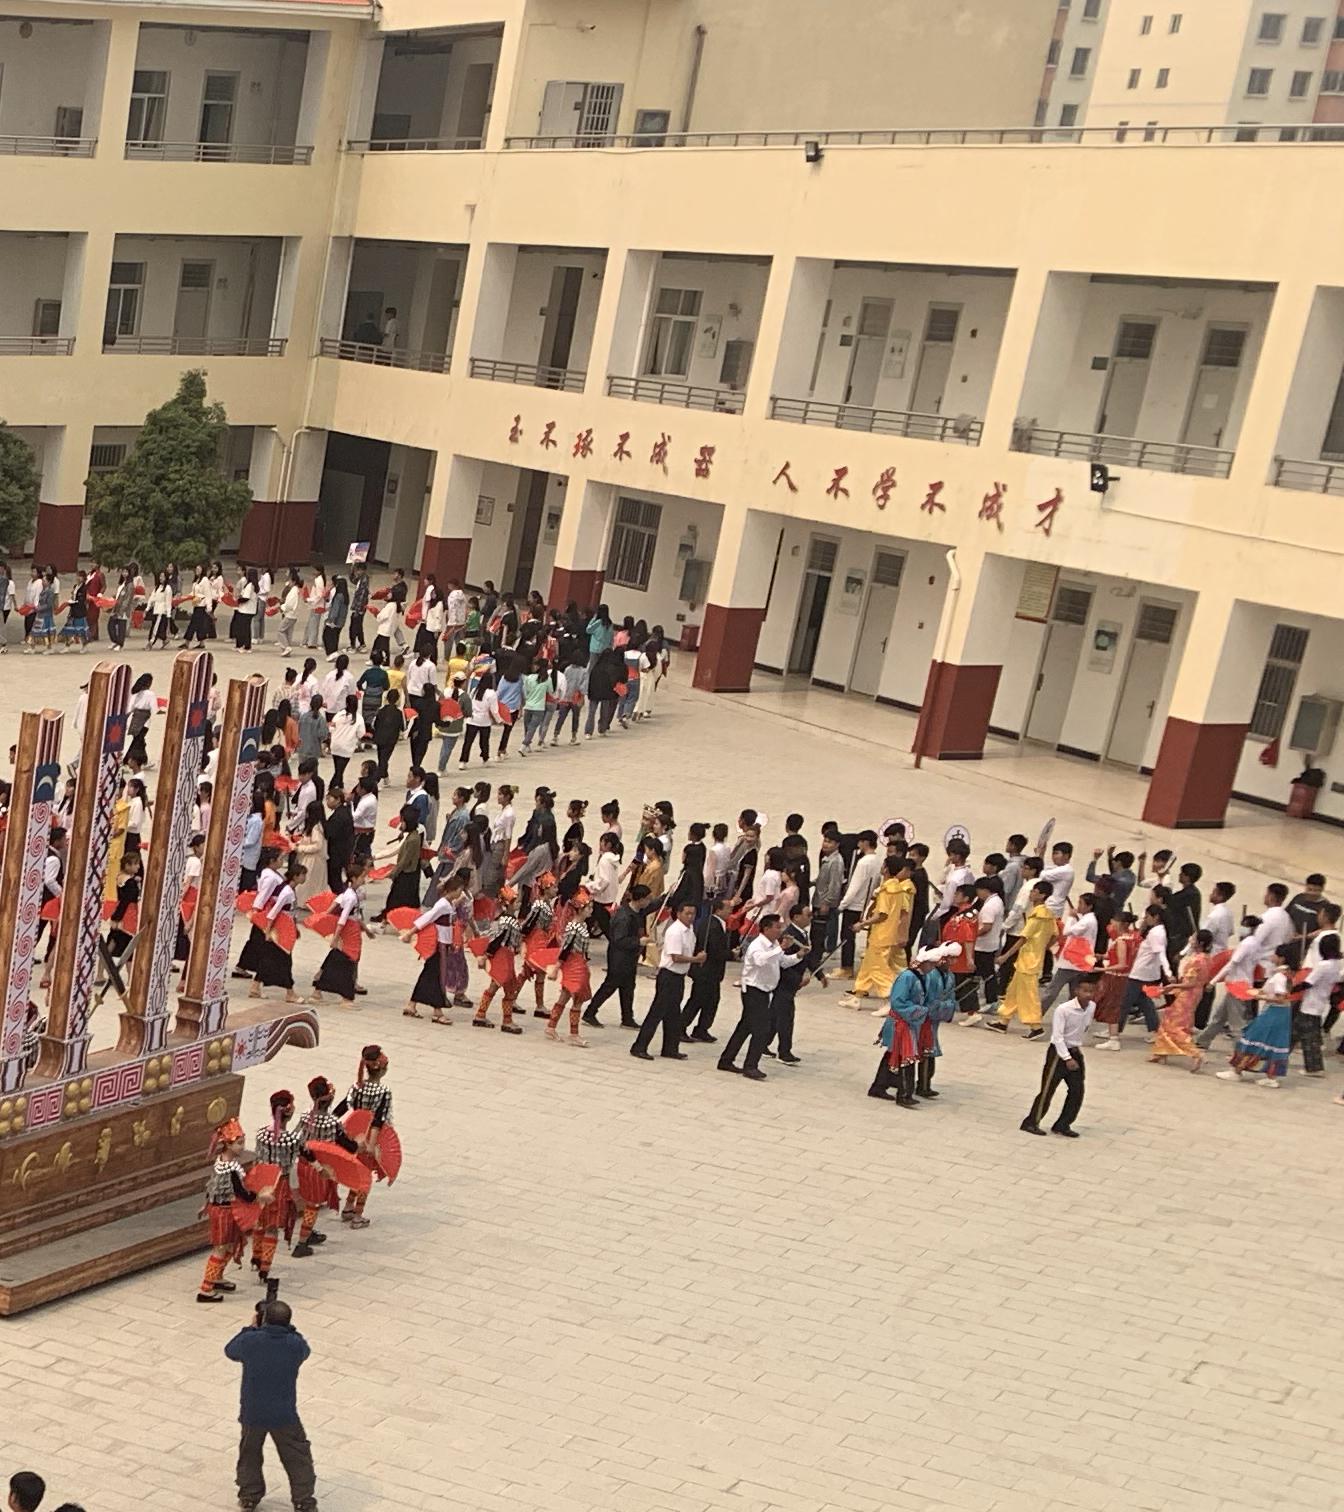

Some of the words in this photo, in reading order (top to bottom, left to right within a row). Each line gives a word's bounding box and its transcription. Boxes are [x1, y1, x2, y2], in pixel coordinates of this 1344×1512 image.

[509, 414, 715, 478] 玉不琢不成器
[772, 461, 1063, 536] 人不学不成才
